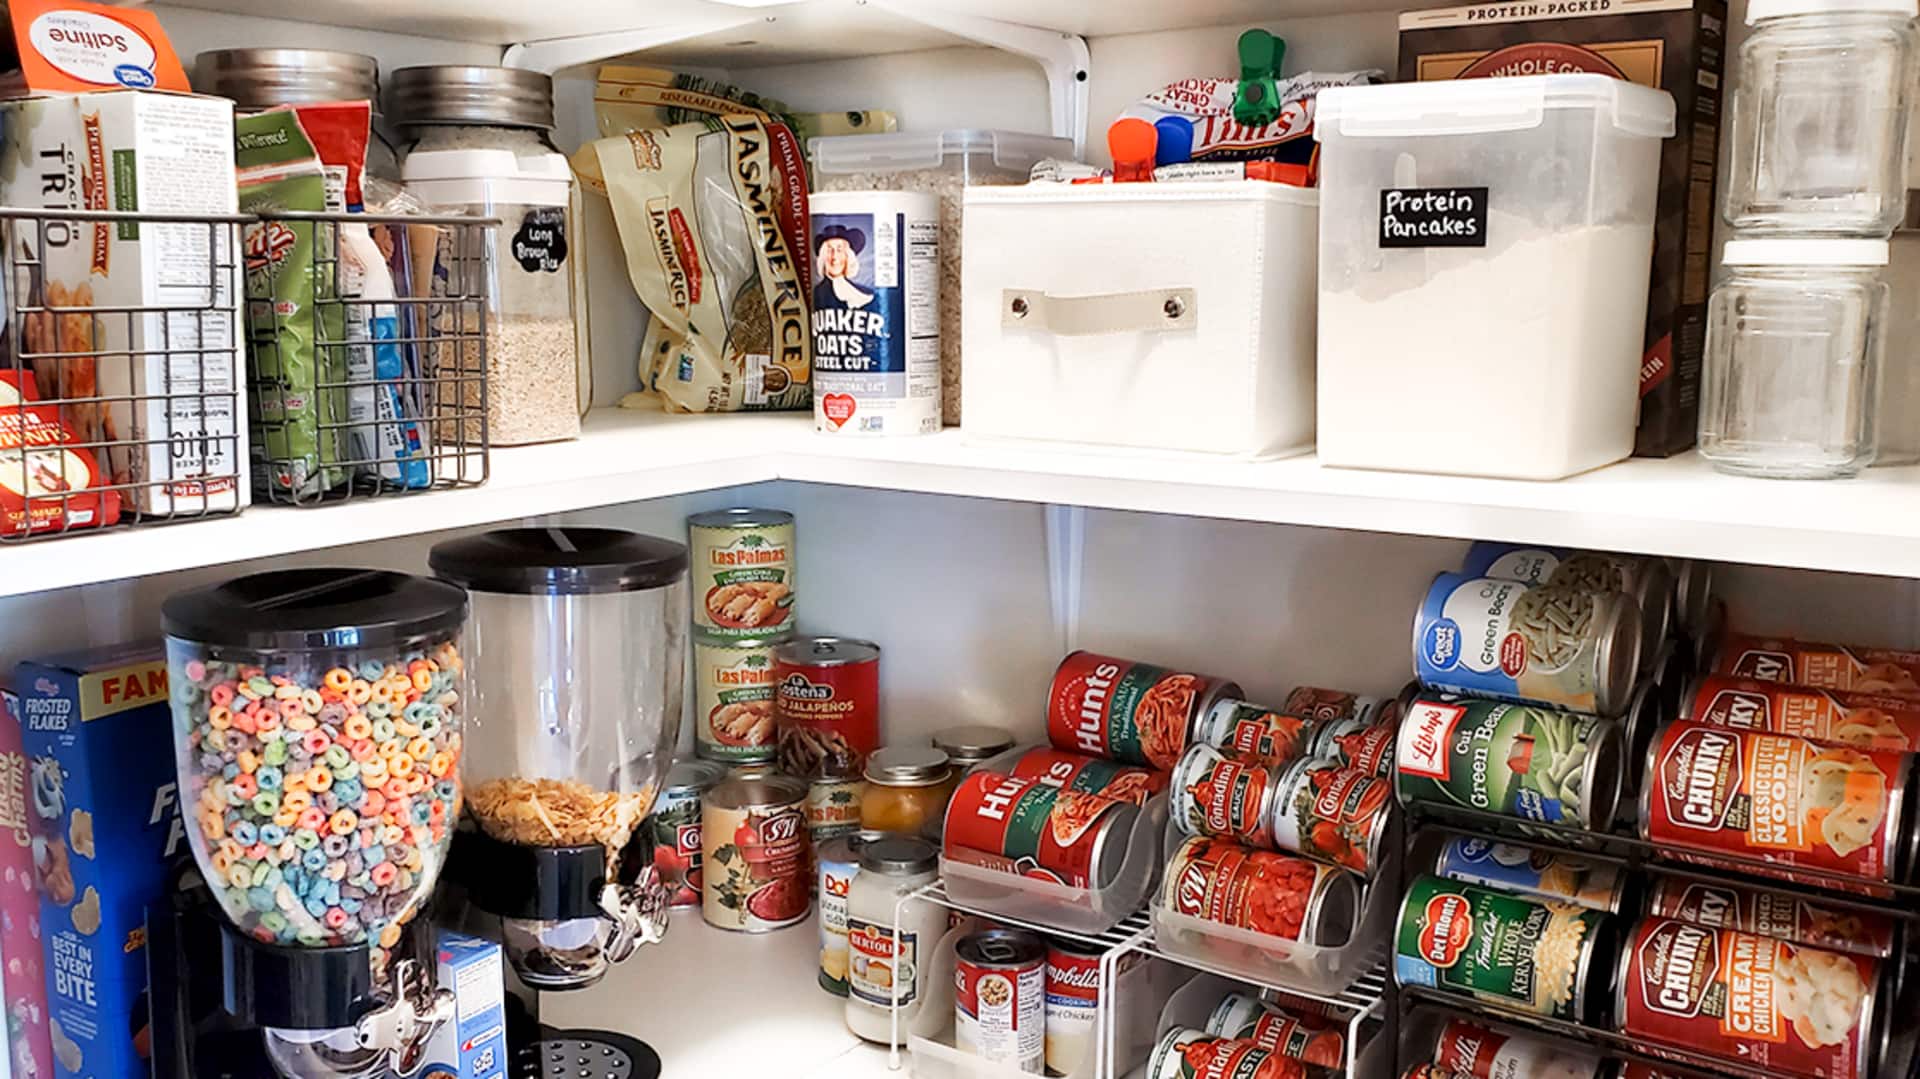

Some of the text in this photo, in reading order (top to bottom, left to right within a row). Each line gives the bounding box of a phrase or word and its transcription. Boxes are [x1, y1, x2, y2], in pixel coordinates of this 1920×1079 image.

[1467, 0, 1611, 21] PROTEIN-PACKED
[49, 28, 128, 53] Saltine
[1490, 60, 1555, 78] WHOLE
[1164, 89, 1210, 108] GREAT
[87, 126, 106, 211] PEPPERIDG
[777, 131, 797, 174] PRIME
[789, 175, 805, 217] GRADE
[39, 143, 70, 247] TRIO
[67, 150, 80, 241] CRACR
[1385, 191, 1473, 214] Protein
[528, 228, 553, 247] Long
[727, 118, 804, 363] JASMINE RICE
[1383, 215, 1477, 238] Pancakes
[516, 242, 549, 261] Brown
[651, 208, 687, 312] JASMINE RICE
[812, 309, 885, 338] QUAKER
[817, 334, 863, 355] OATS
[815, 356, 871, 370] STEEL CUT
[1639, 356, 1664, 383] TEIN
[175, 458, 221, 468] CRCKER
[711, 548, 785, 566] Las Palmas
[1480, 582, 1500, 599] Cut
[1487, 584, 1514, 618] Beans
[1431, 625, 1448, 665] Great
[1480, 616, 1501, 666] Green
[102, 668, 169, 705] FAM
[715, 668, 739, 684] Las
[791, 676, 804, 686] La
[25, 698, 72, 715] FROSTED
[28, 715, 69, 731] FLAKES
[1111, 714, 1121, 752] PASTA
[1411, 710, 1445, 768] Libby's
[1456, 729, 1473, 755] Cut
[1470, 746, 1489, 808] Green
[1682, 732, 1731, 824] CHUNKY
[1771, 736, 1792, 844] NOODLE
[9, 751, 32, 848] Charms
[1209, 764, 1235, 829] Contadina
[1231, 780, 1249, 826] SAUCE
[1755, 781, 1773, 843] CLASSIC
[825, 873, 849, 894] Dol
[850, 932, 897, 954] BERTOLL
[1430, 897, 1459, 961] Del Monte
[1497, 920, 1525, 968] WHOLE
[52, 935, 92, 963] BEST IN
[54, 951, 93, 979] EVERY
[1475, 935, 1495, 971] Fresh
[1465, 953, 1475, 986] MADE
[1511, 939, 1536, 996] KERNEL
[1659, 924, 1708, 1010] CHUNKY
[1732, 934, 1757, 1032] CREAMY
[55, 967, 97, 1007] BITE
[1753, 971, 1771, 1035] CHICKEN
[1236, 1049, 1264, 1079] ASTE
